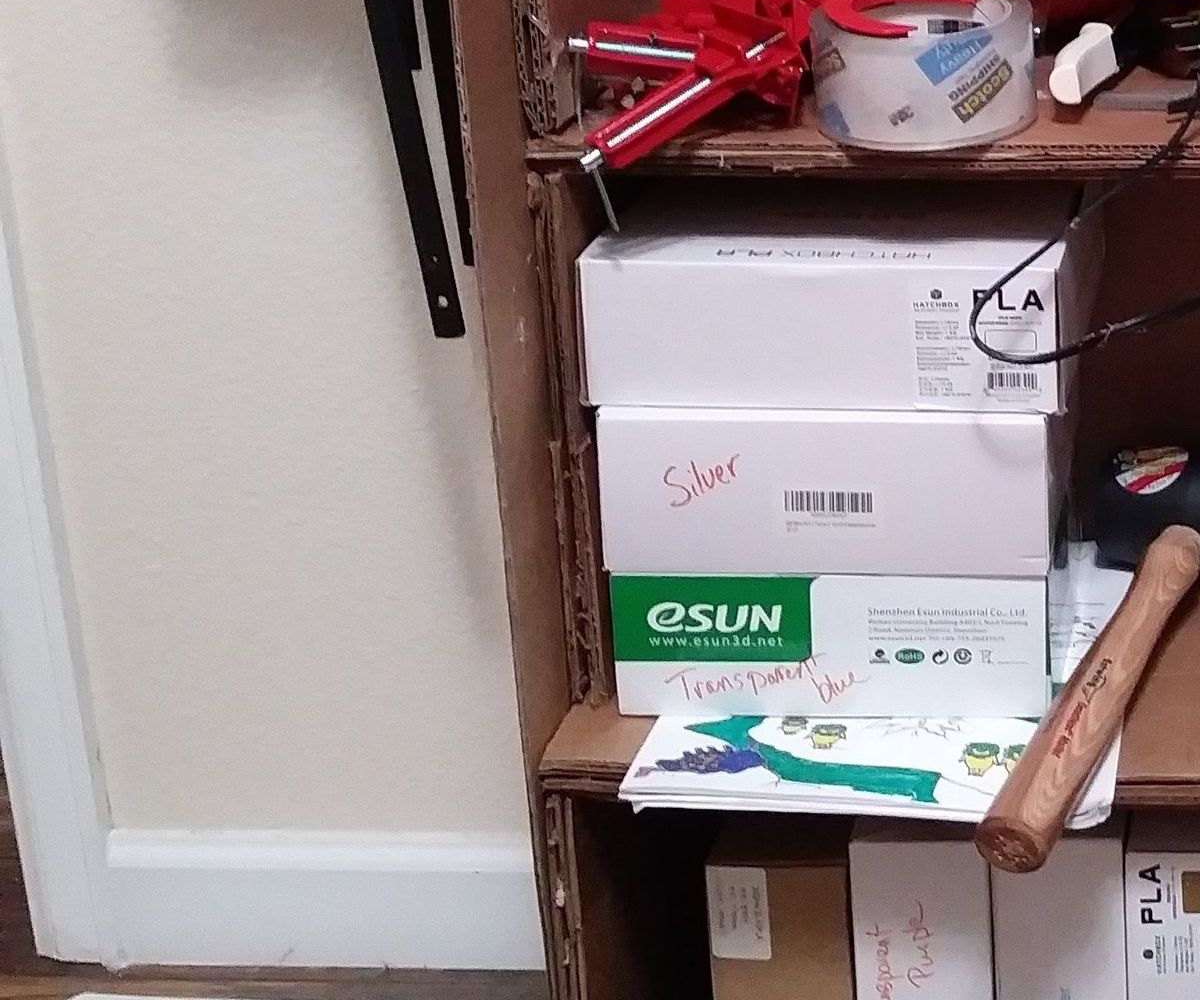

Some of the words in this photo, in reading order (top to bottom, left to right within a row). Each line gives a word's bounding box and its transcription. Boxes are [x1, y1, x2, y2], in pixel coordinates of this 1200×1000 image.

[956, 60, 1013, 118] Scotch
[912, 301, 960, 309] HATCHBOX
[972, 288, 1045, 312] PLA
[662, 453, 740, 508] Silver
[867, 606, 916, 617] Shenzhen
[648, 635, 784, 648] www.esun3d.net
[810, 670, 871, 704] blue
[1138, 863, 1164, 926] PLA
